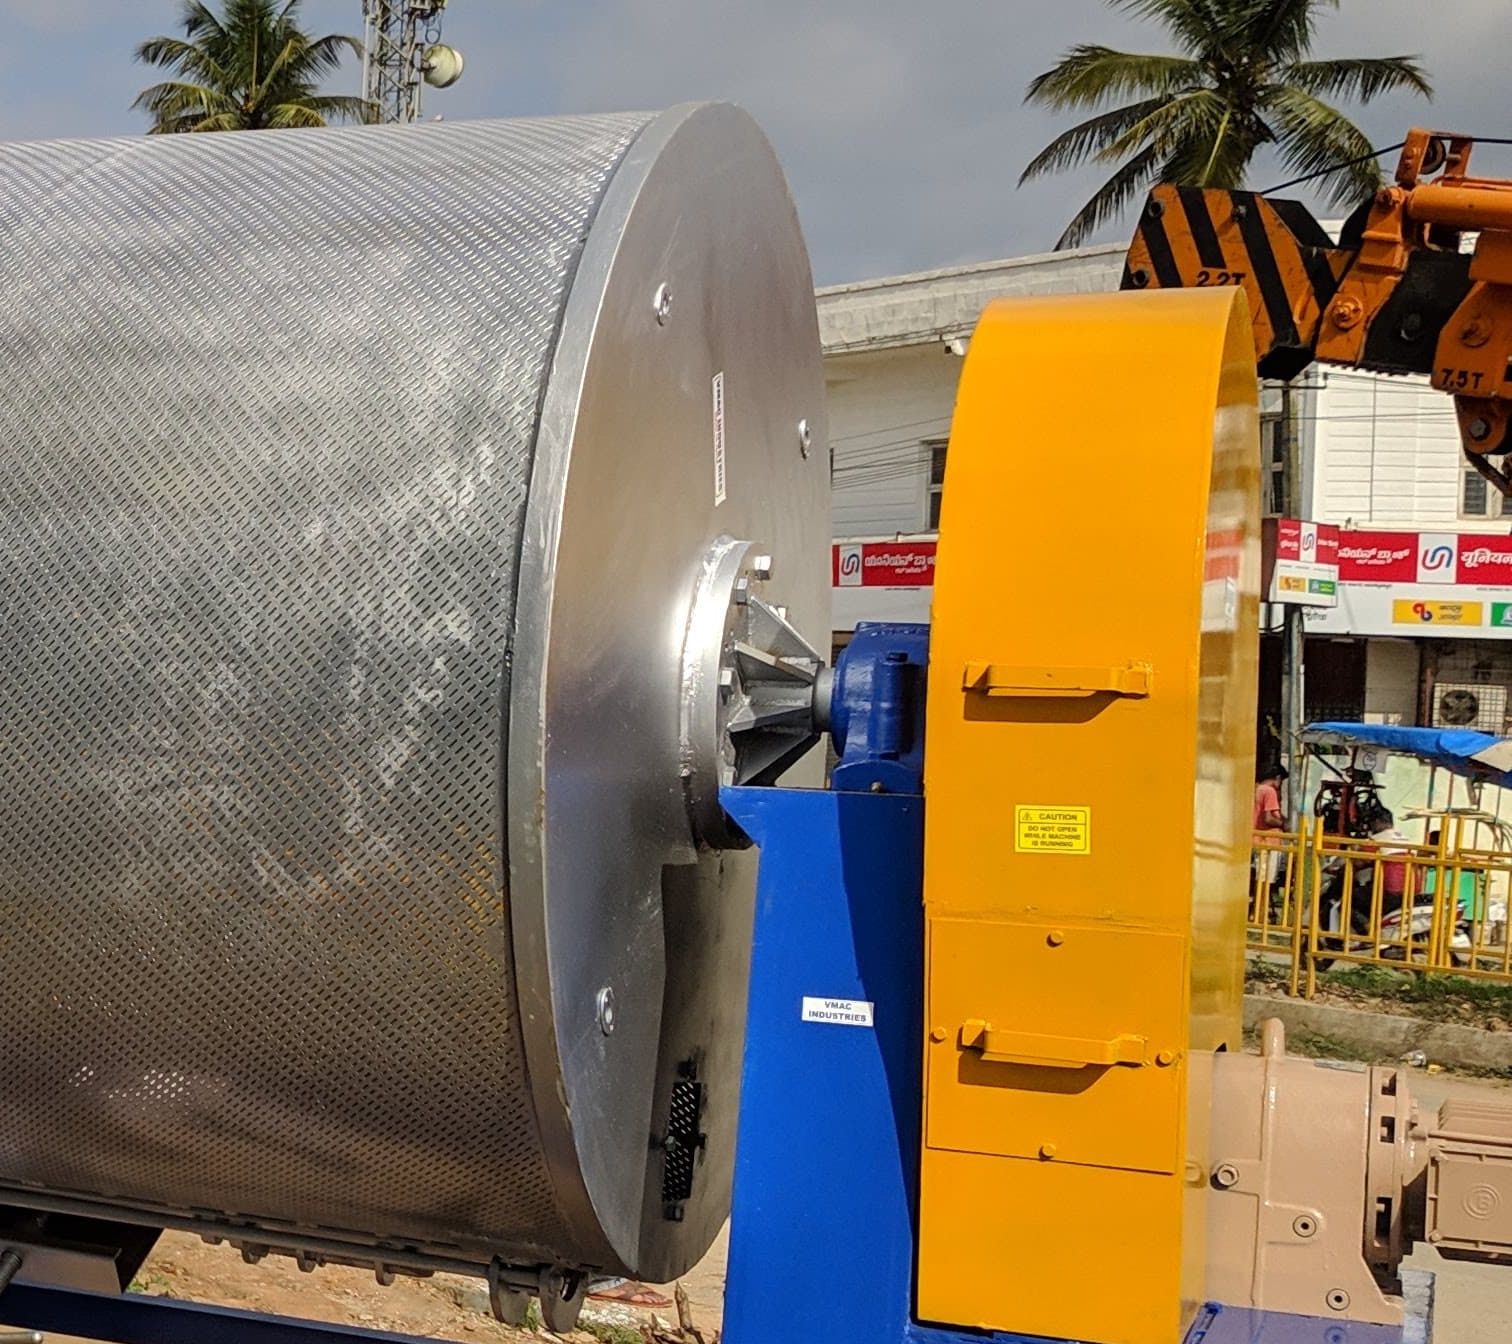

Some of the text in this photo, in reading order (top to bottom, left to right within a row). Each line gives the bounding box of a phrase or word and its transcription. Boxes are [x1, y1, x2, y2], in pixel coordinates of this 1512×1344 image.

[1039, 813, 1078, 821] CAUTION
[824, 1000, 853, 1011] VMAC
[808, 1010, 867, 1023] INDUSTRIES
